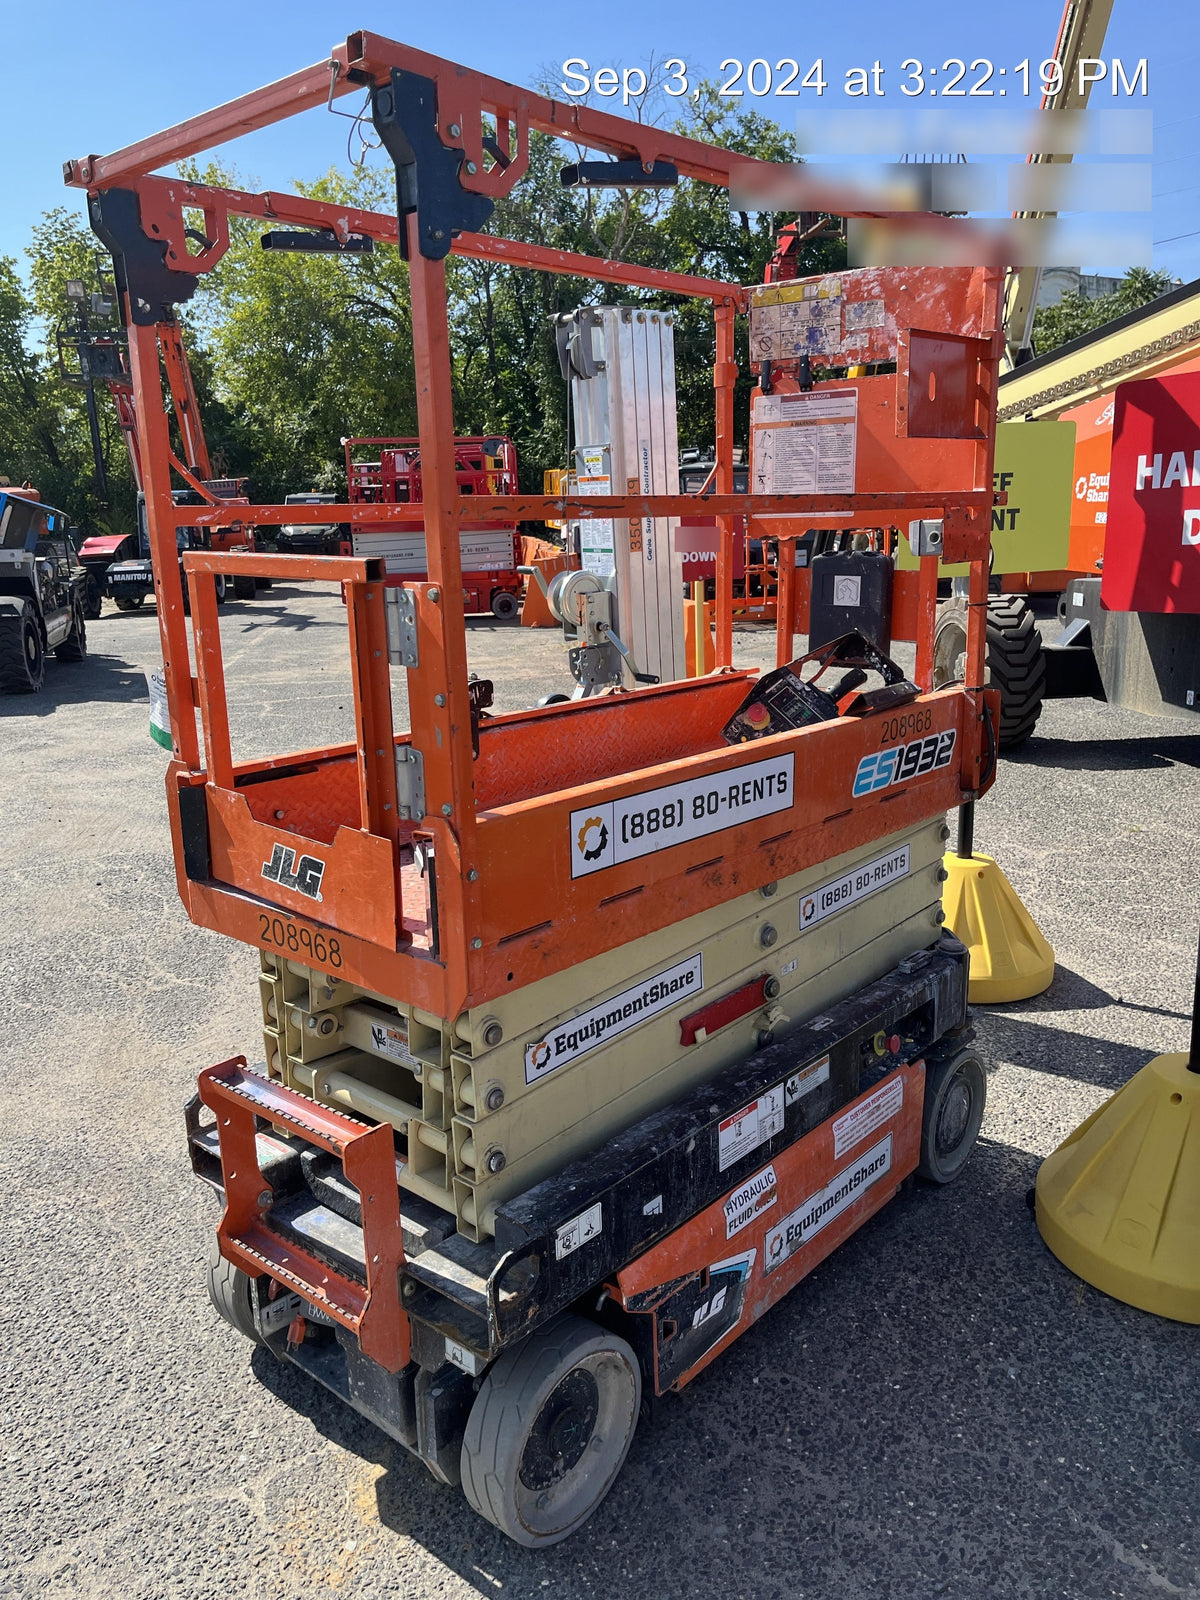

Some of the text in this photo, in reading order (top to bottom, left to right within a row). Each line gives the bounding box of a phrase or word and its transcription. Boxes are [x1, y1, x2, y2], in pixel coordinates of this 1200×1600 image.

[991, 508, 1021, 531] NT
[113, 573, 147, 581] MANITOU
[880, 709, 932, 743] 208968
[853, 730, 955, 796] ES1932
[620, 771, 788, 844] (888) 80-RENTS
[261, 843, 325, 901] JLG
[821, 852, 907, 909] (888) 80-RENTS
[258, 914, 342, 968] 208968
[555, 968, 695, 1056] EquipmentShare
[725, 1172, 775, 1216] HYDRAULIC
[728, 1207, 753, 1233] FLUID
[786, 1153, 886, 1244] EquipmentShare
